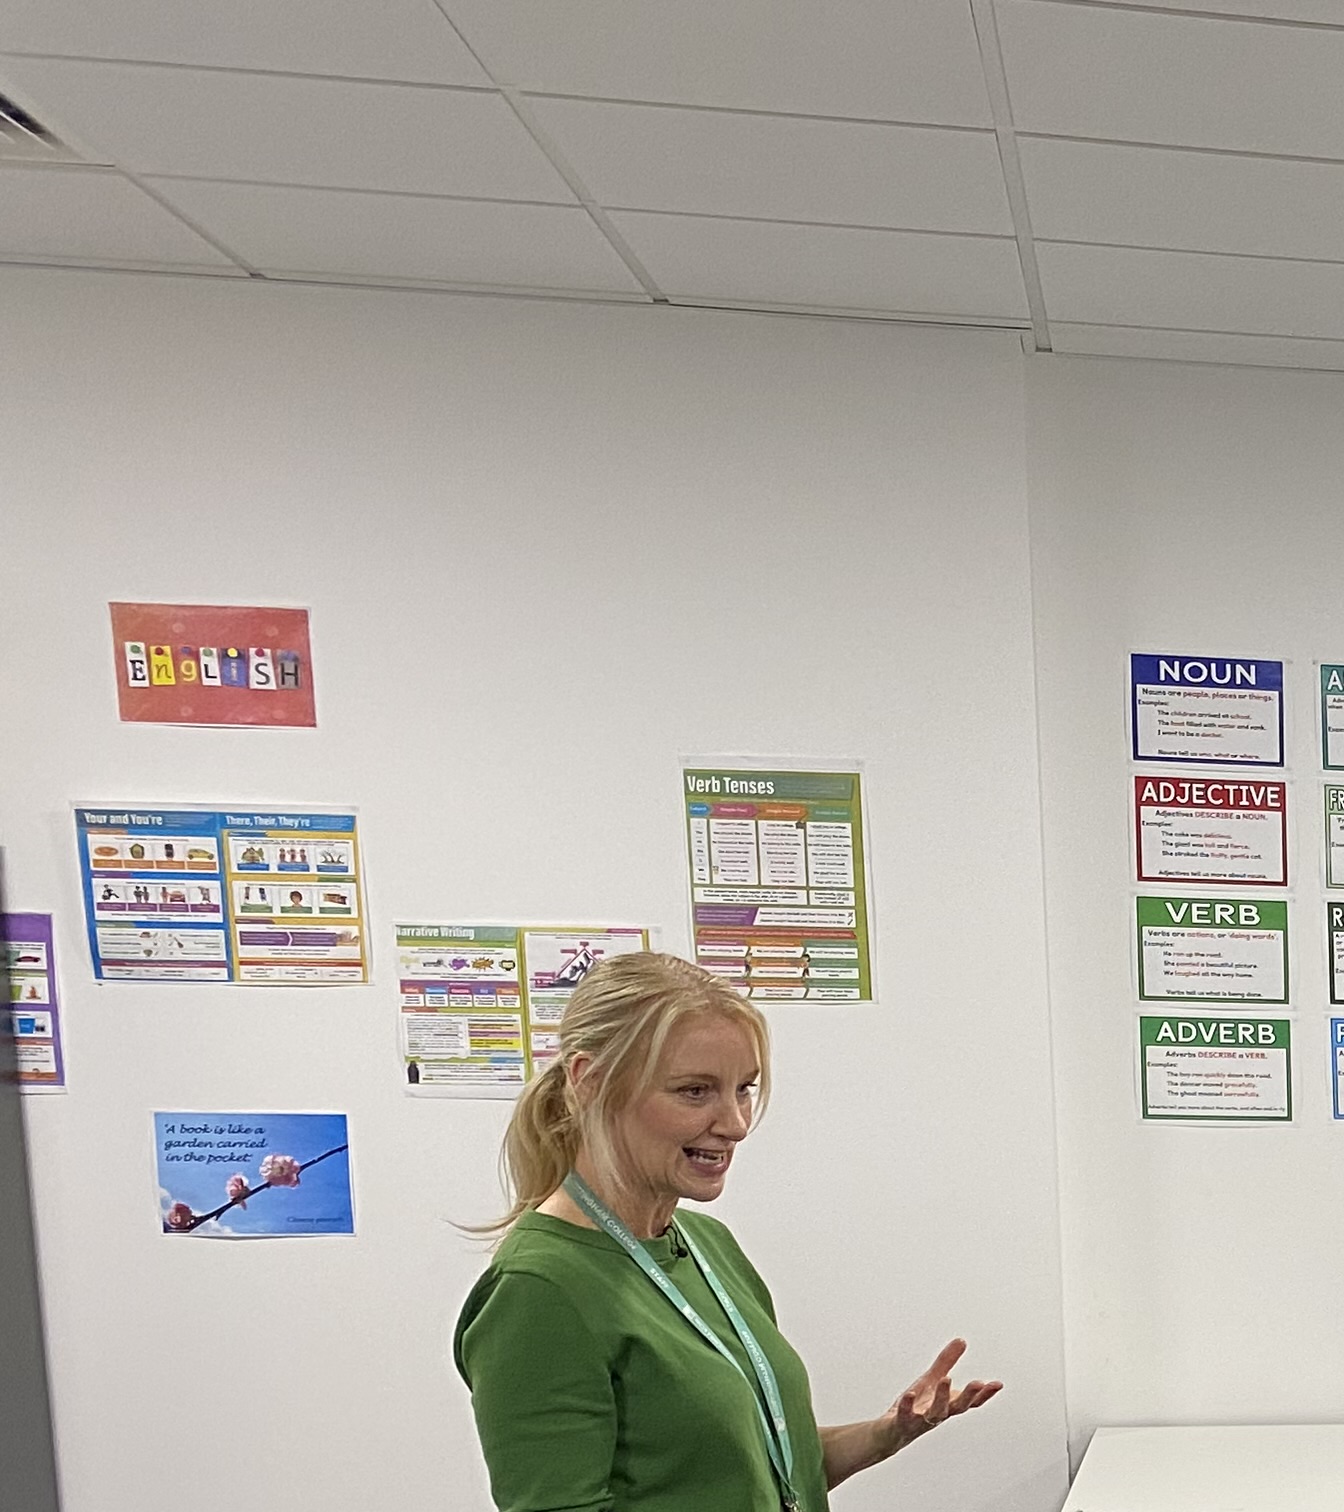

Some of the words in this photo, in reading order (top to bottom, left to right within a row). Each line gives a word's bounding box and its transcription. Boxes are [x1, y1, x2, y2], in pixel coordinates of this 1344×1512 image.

[1159, 660, 1256, 685] NOUN
[1142, 688, 1166, 696] Nouns
[687, 776, 720, 793] Verb
[723, 777, 775, 794] Tenses
[1141, 782, 1281, 807] ADJECTIVE
[84, 812, 108, 823] Your
[110, 814, 128, 824] and
[130, 814, 163, 825] You're
[1155, 810, 1193, 818] Adjectives
[225, 815, 253, 826] There,
[254, 816, 278, 826] Their,
[278, 816, 310, 828] They're
[1165, 902, 1261, 925] VERB
[440, 927, 475, 940] Writing
[1156, 1021, 1276, 1044] ADVERB
[1198, 1051, 1237, 1059] DESCRIBE
[180, 1124, 212, 1134] book
[214, 1125, 225, 1134] is
[227, 1124, 253, 1134] like
[164, 1137, 214, 1151] garden
[216, 1138, 268, 1149] carried
[165, 1153, 183, 1162] in
[184, 1153, 206, 1162] the
